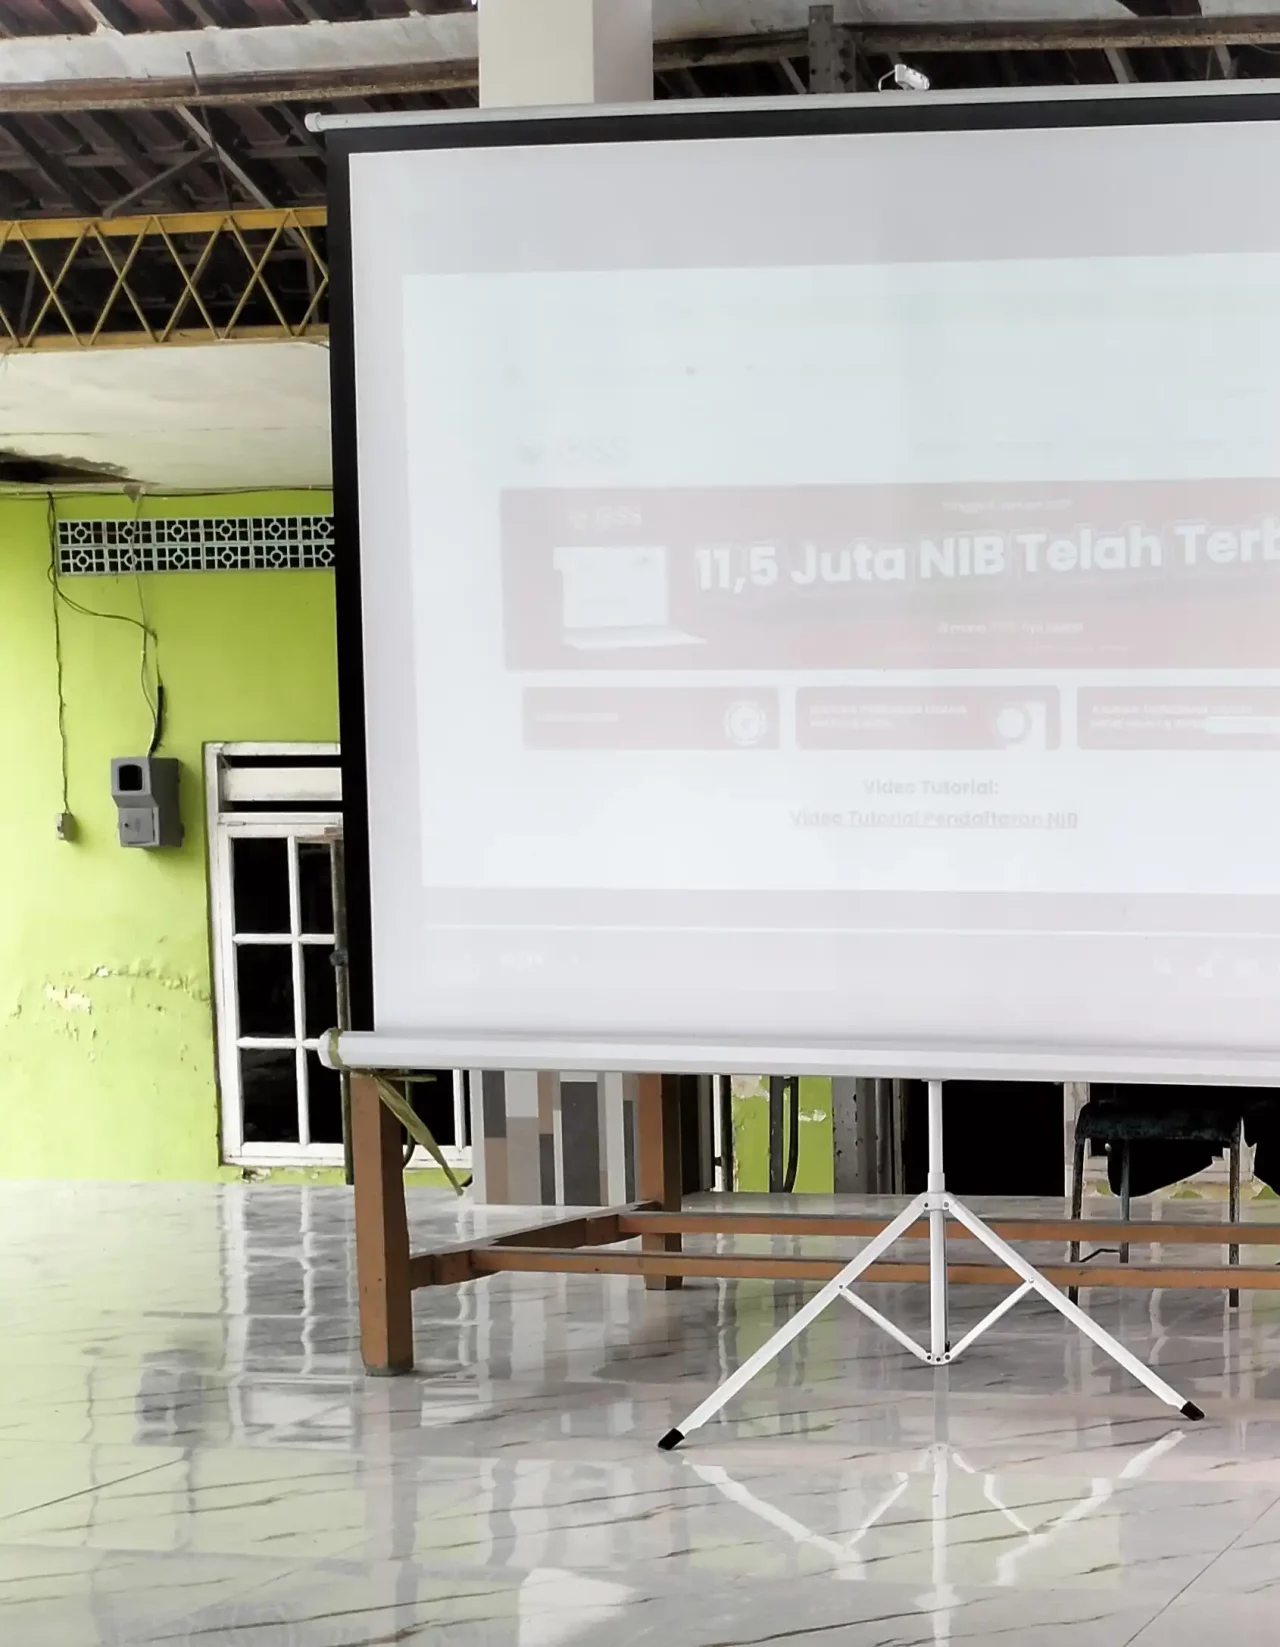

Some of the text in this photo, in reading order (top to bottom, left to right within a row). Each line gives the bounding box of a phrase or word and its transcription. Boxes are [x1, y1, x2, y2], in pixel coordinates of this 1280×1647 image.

[695, 546, 779, 594] 11,5
[790, 543, 906, 585] Juta
[920, 535, 1006, 579] NIB
[1015, 525, 1162, 572] Telah
